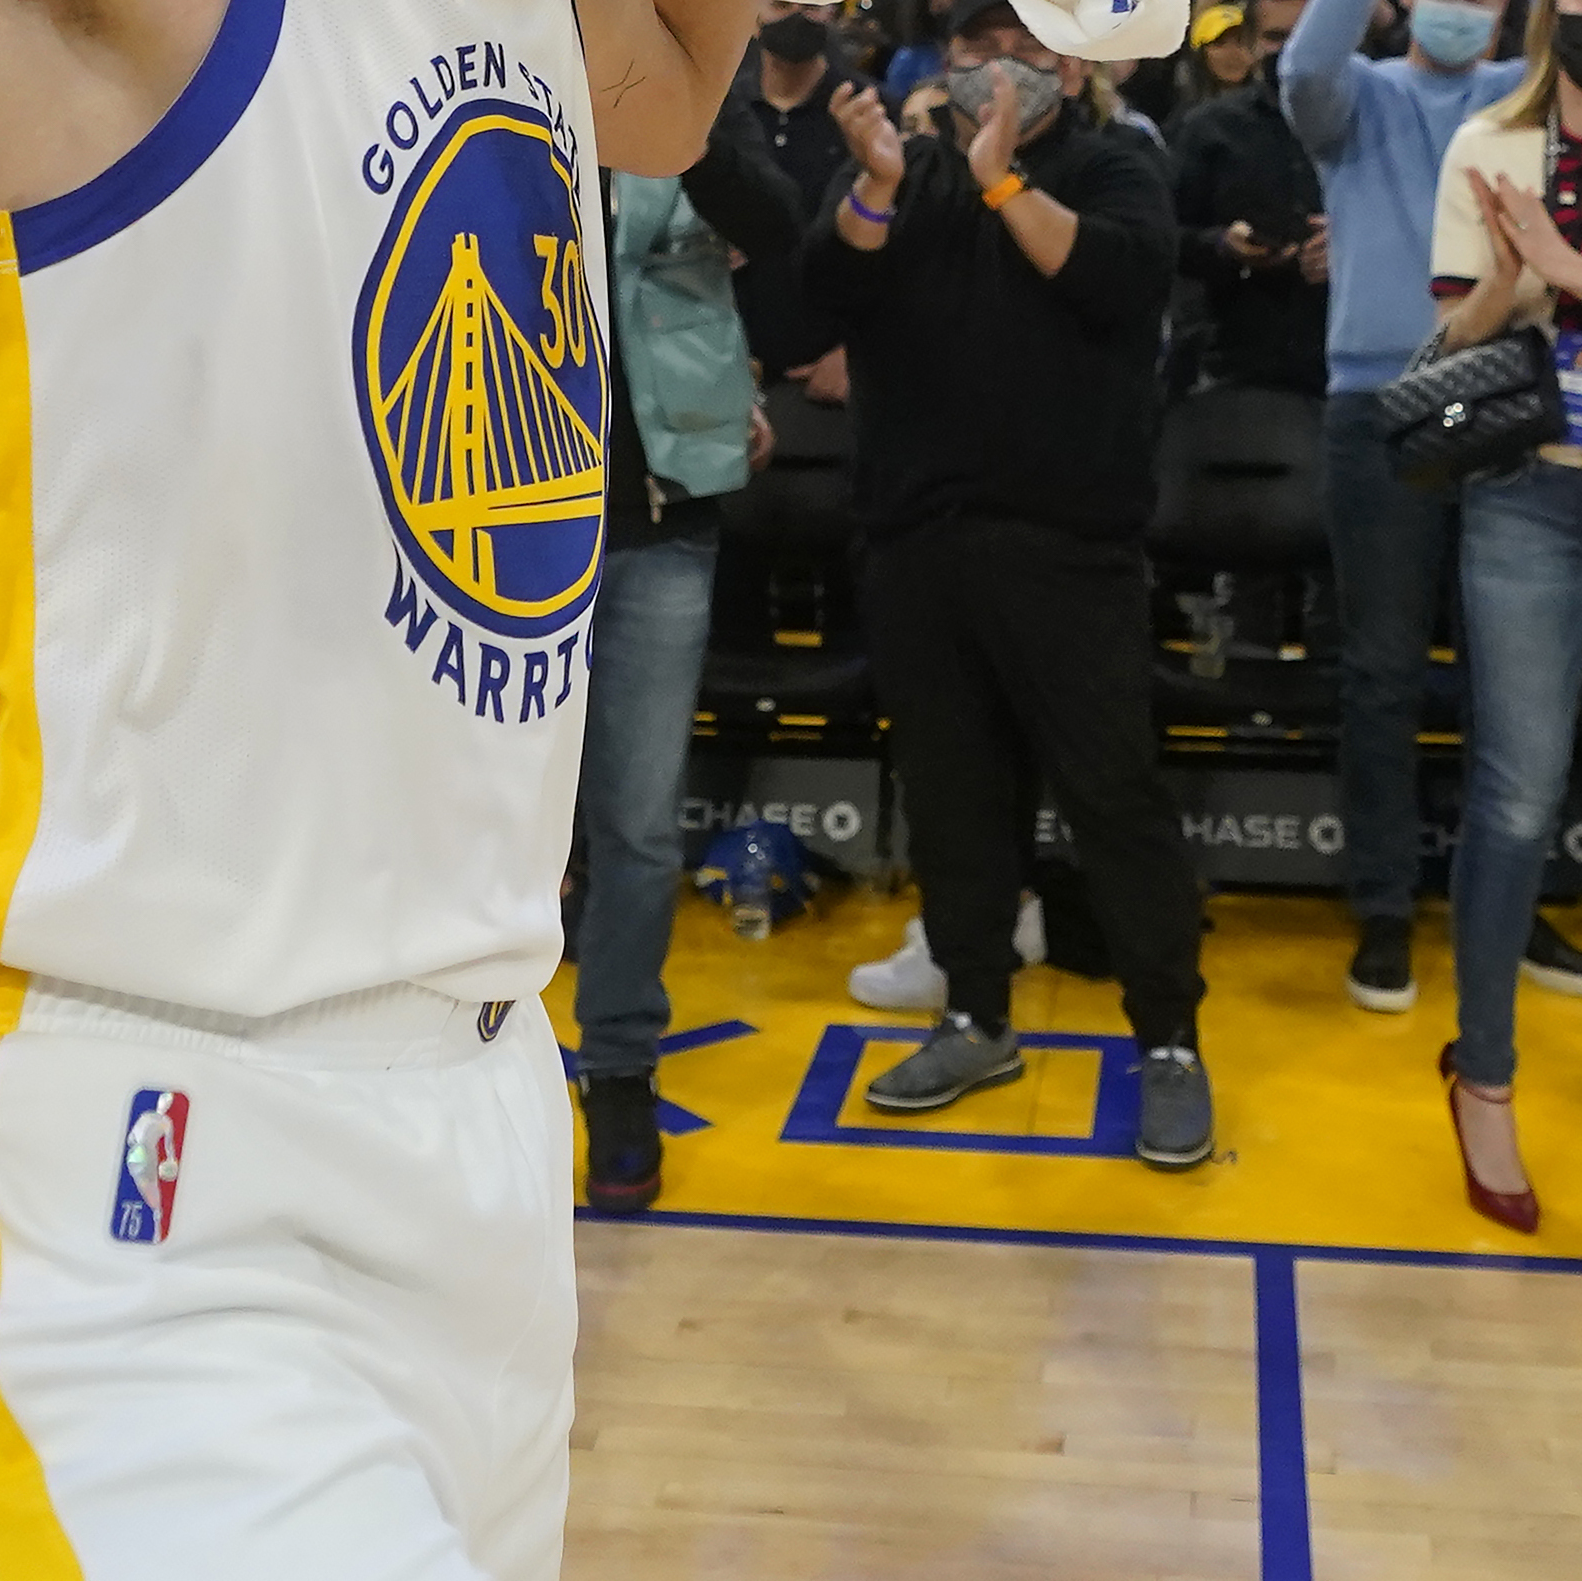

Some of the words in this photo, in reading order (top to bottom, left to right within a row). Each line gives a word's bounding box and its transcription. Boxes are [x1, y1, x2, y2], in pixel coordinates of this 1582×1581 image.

[362, 41, 507, 196] GOLDEN
[534, 233, 587, 369] 30
[1181, 814, 1300, 849] HASE
[119, 1200, 144, 1238] 75
